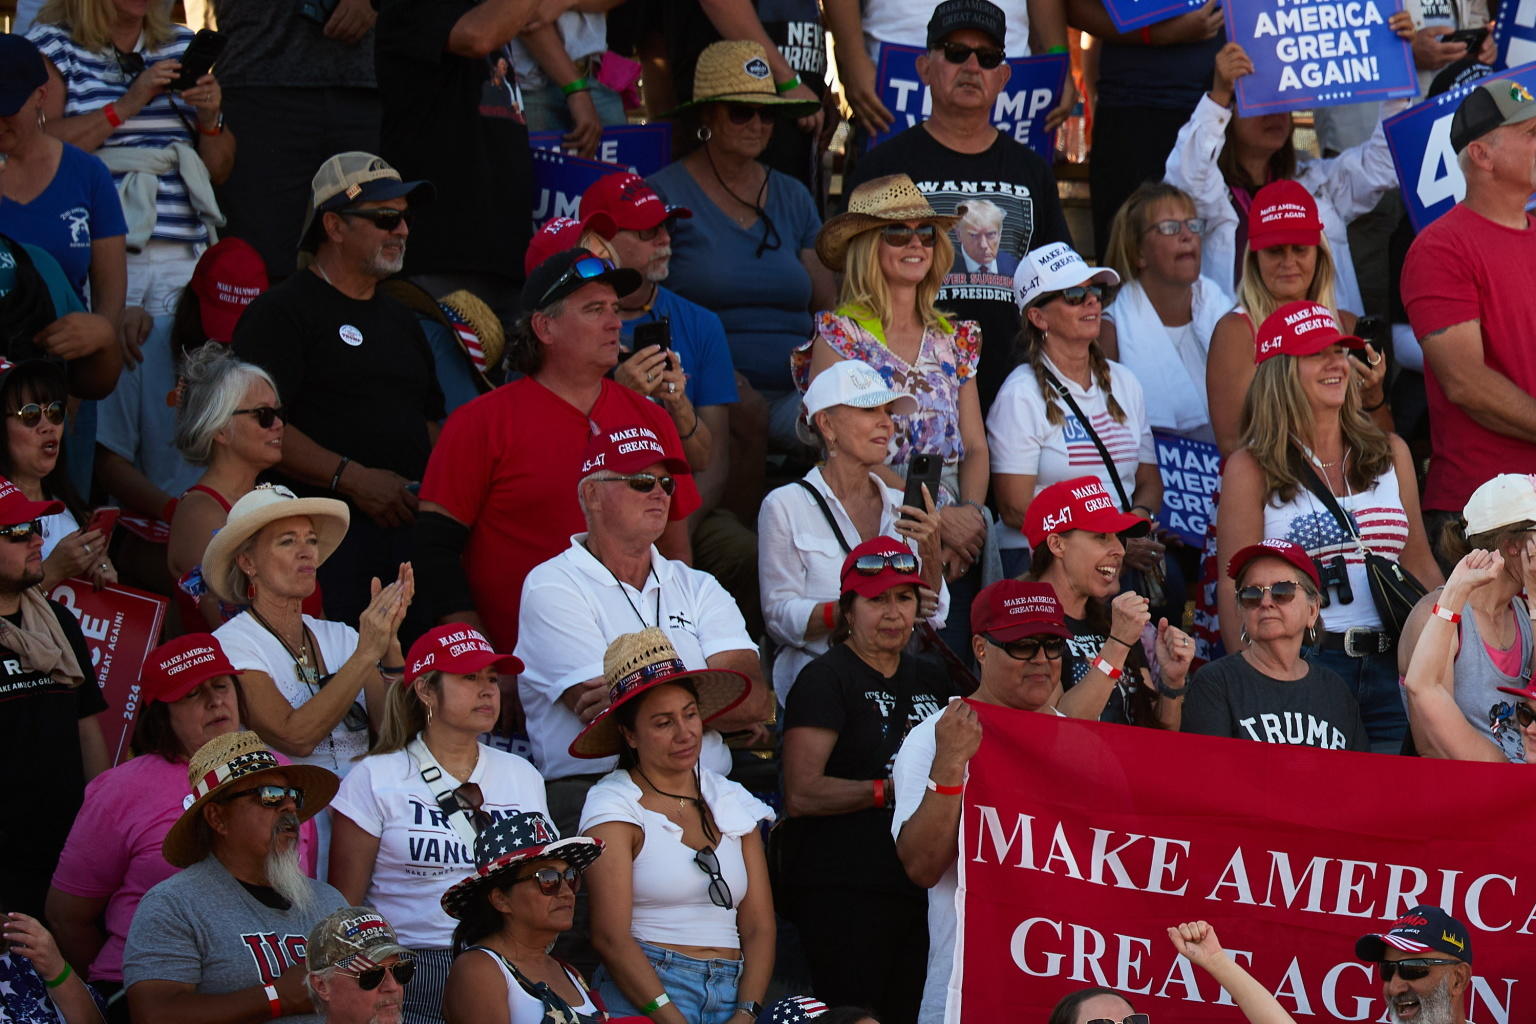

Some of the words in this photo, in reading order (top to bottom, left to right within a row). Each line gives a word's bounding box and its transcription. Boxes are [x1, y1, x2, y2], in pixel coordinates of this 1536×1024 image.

[1253, 5, 1384, 39] AMERICA
[1275, 29, 1371, 62] GREAT
[1278, 56, 1379, 93] AGAIN!
[915, 179, 1031, 198] WANTED
[1284, 307, 1312, 326] MAKE
[1294, 317, 1323, 335] GREAT
[1260, 335, 1283, 353] 45-47
[609, 427, 638, 444] MAKE
[618, 439, 649, 456] GREAT
[581, 452, 607, 474] 45-47
[1071, 483, 1101, 500] MAKE
[1042, 506, 1073, 532] 45-47
[1003, 599, 1026, 608] MAKE
[1026, 595, 1057, 606] AMERICA
[1009, 605, 1034, 615] GREAT
[1034, 604, 1055, 613] AGAIN
[438, 629, 468, 647] MAKE
[450, 641, 478, 657] GREAT
[97, 655, 113, 689] GREAT
[108, 611, 125, 653] AGAIN!
[160, 656, 183, 672] MAKE
[182, 646, 216, 663] AMERICA
[167, 660, 195, 676] GREAT
[193, 654, 216, 669] AGAIN
[411, 652, 436, 674] 45-47
[123, 683, 142, 721] 2024
[1238, 710, 1348, 751] TRUMP
[972, 803, 1192, 898] MAKE
